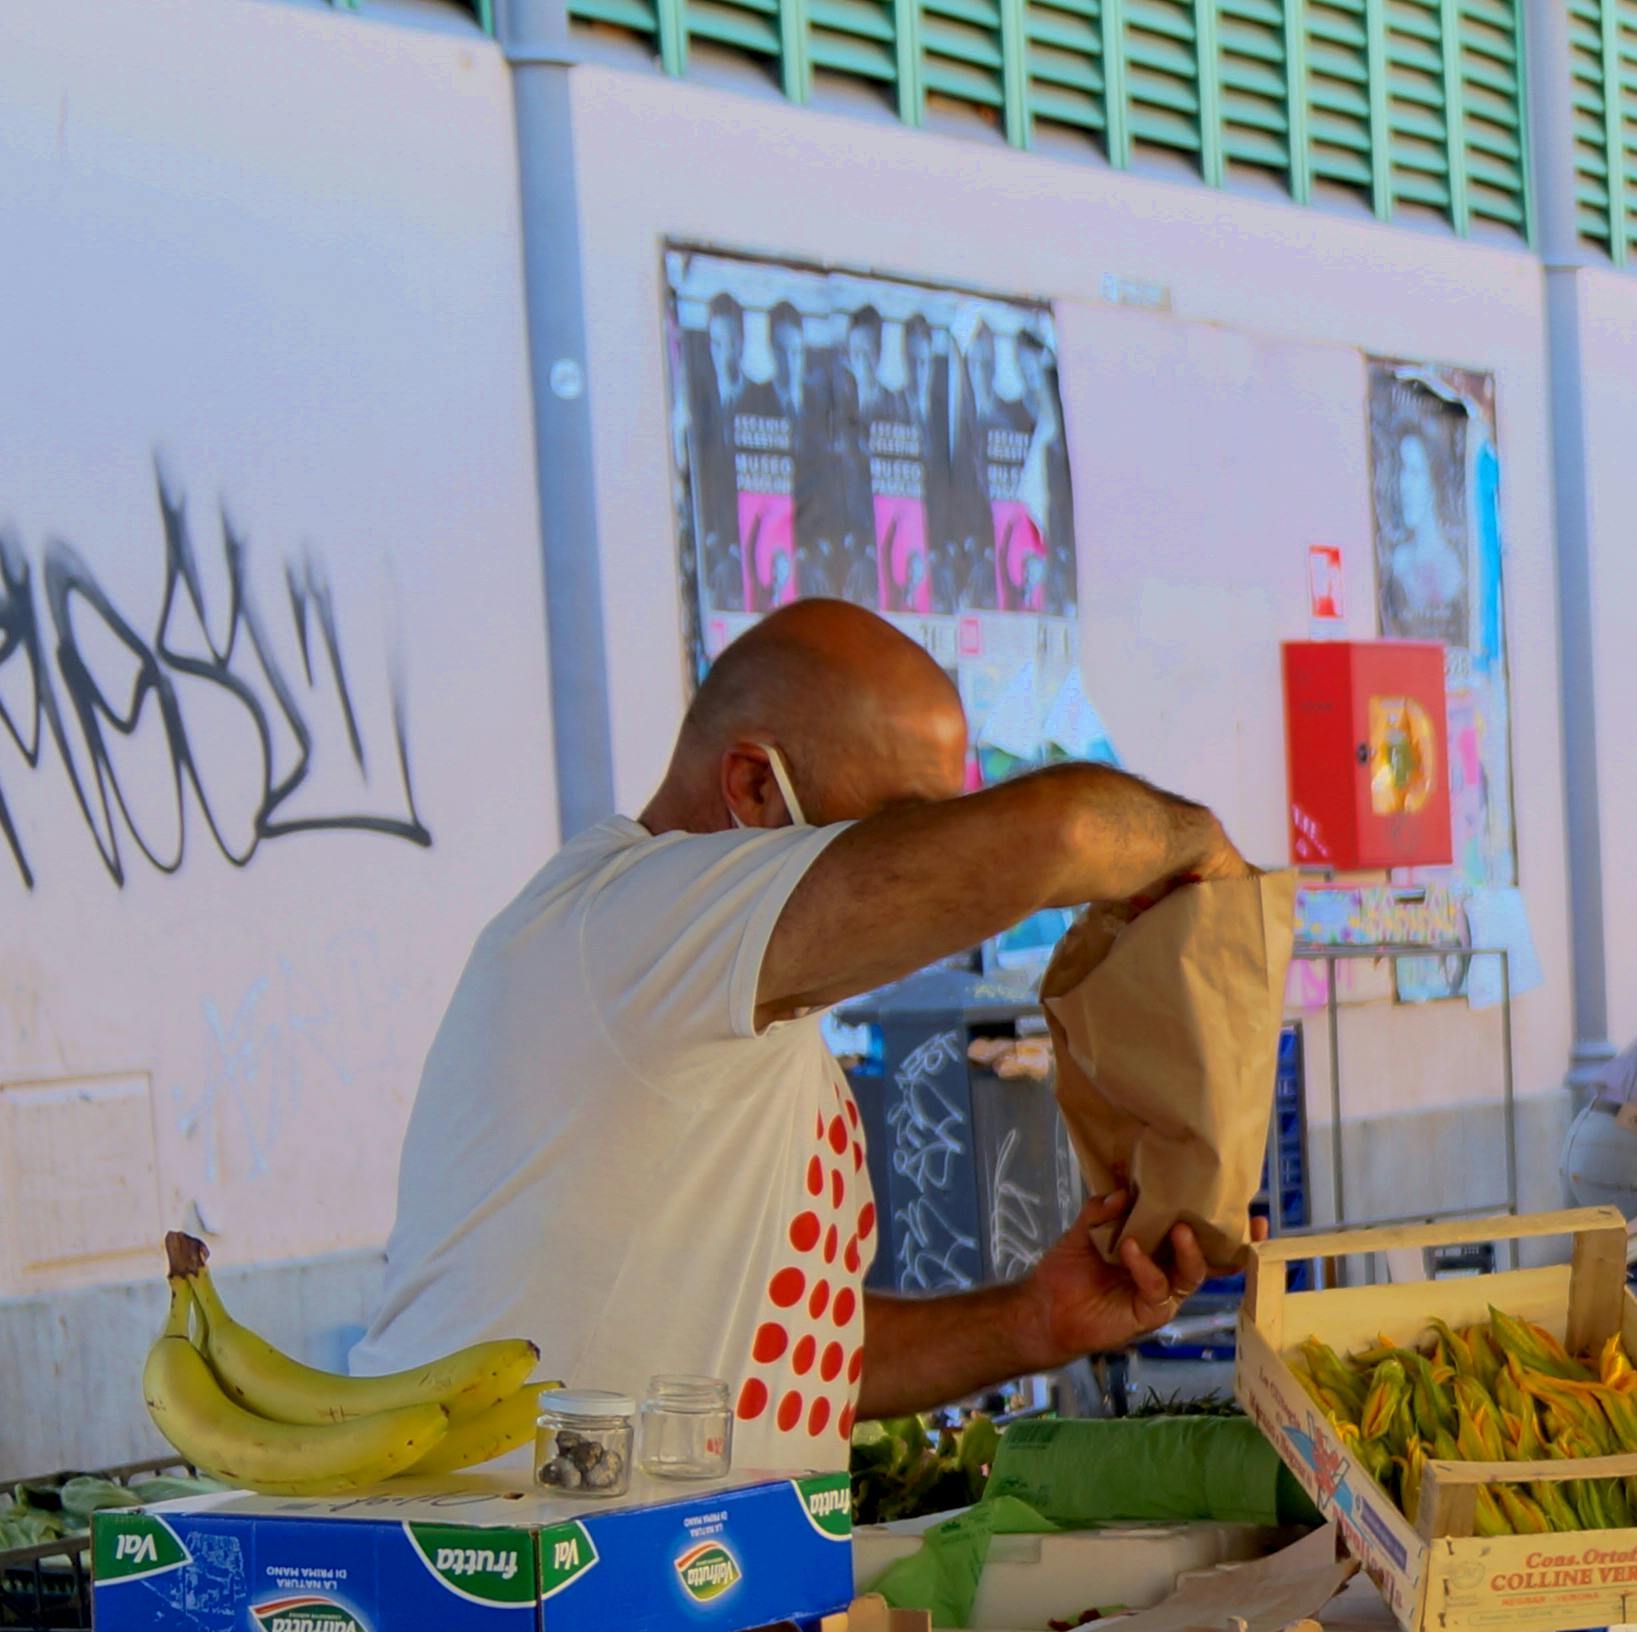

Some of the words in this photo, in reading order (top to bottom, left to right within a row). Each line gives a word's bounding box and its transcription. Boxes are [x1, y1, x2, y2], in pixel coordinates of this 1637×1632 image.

[809, 1489, 850, 1518] frutta
[115, 1534, 158, 1564] Val
[554, 1538, 579, 1570] Val
[265, 1565, 300, 1577] MANO
[301, 1567, 334, 1578] PRIMA
[437, 1548, 518, 1580] frutta
[687, 1560, 733, 1586] Valfrutta
[1490, 1563, 1592, 1592] COLLINE
[276, 1578, 321, 1589] NATURA
